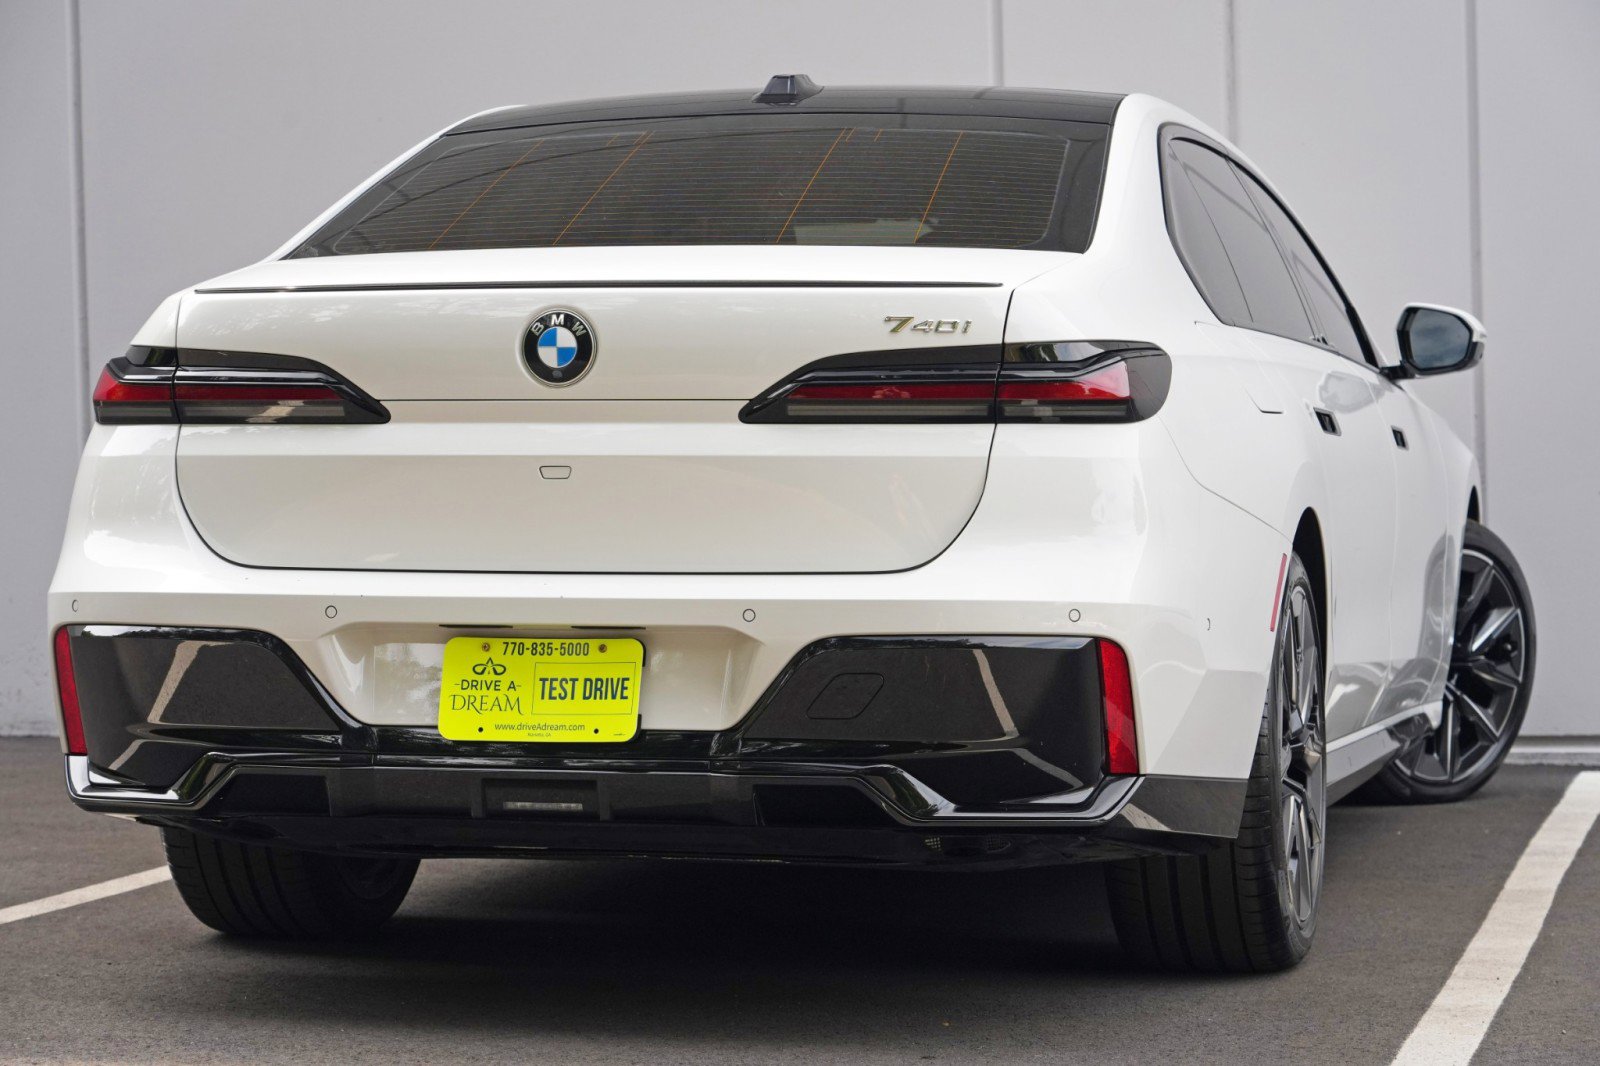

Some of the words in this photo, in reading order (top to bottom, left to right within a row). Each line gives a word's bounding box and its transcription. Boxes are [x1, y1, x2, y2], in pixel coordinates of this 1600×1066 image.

[531, 313, 587, 336] BMW
[884, 315, 972, 334] 740i
[502, 641, 590, 656] 770-835-5000
[460, 679, 502, 691] DRIVE
[507, 680, 517, 691] A
[539, 677, 579, 700] TEST
[582, 677, 630, 700] DRIVE
[449, 693, 524, 715] DREAM
[494, 722, 586, 731] www.driveAdream.com
